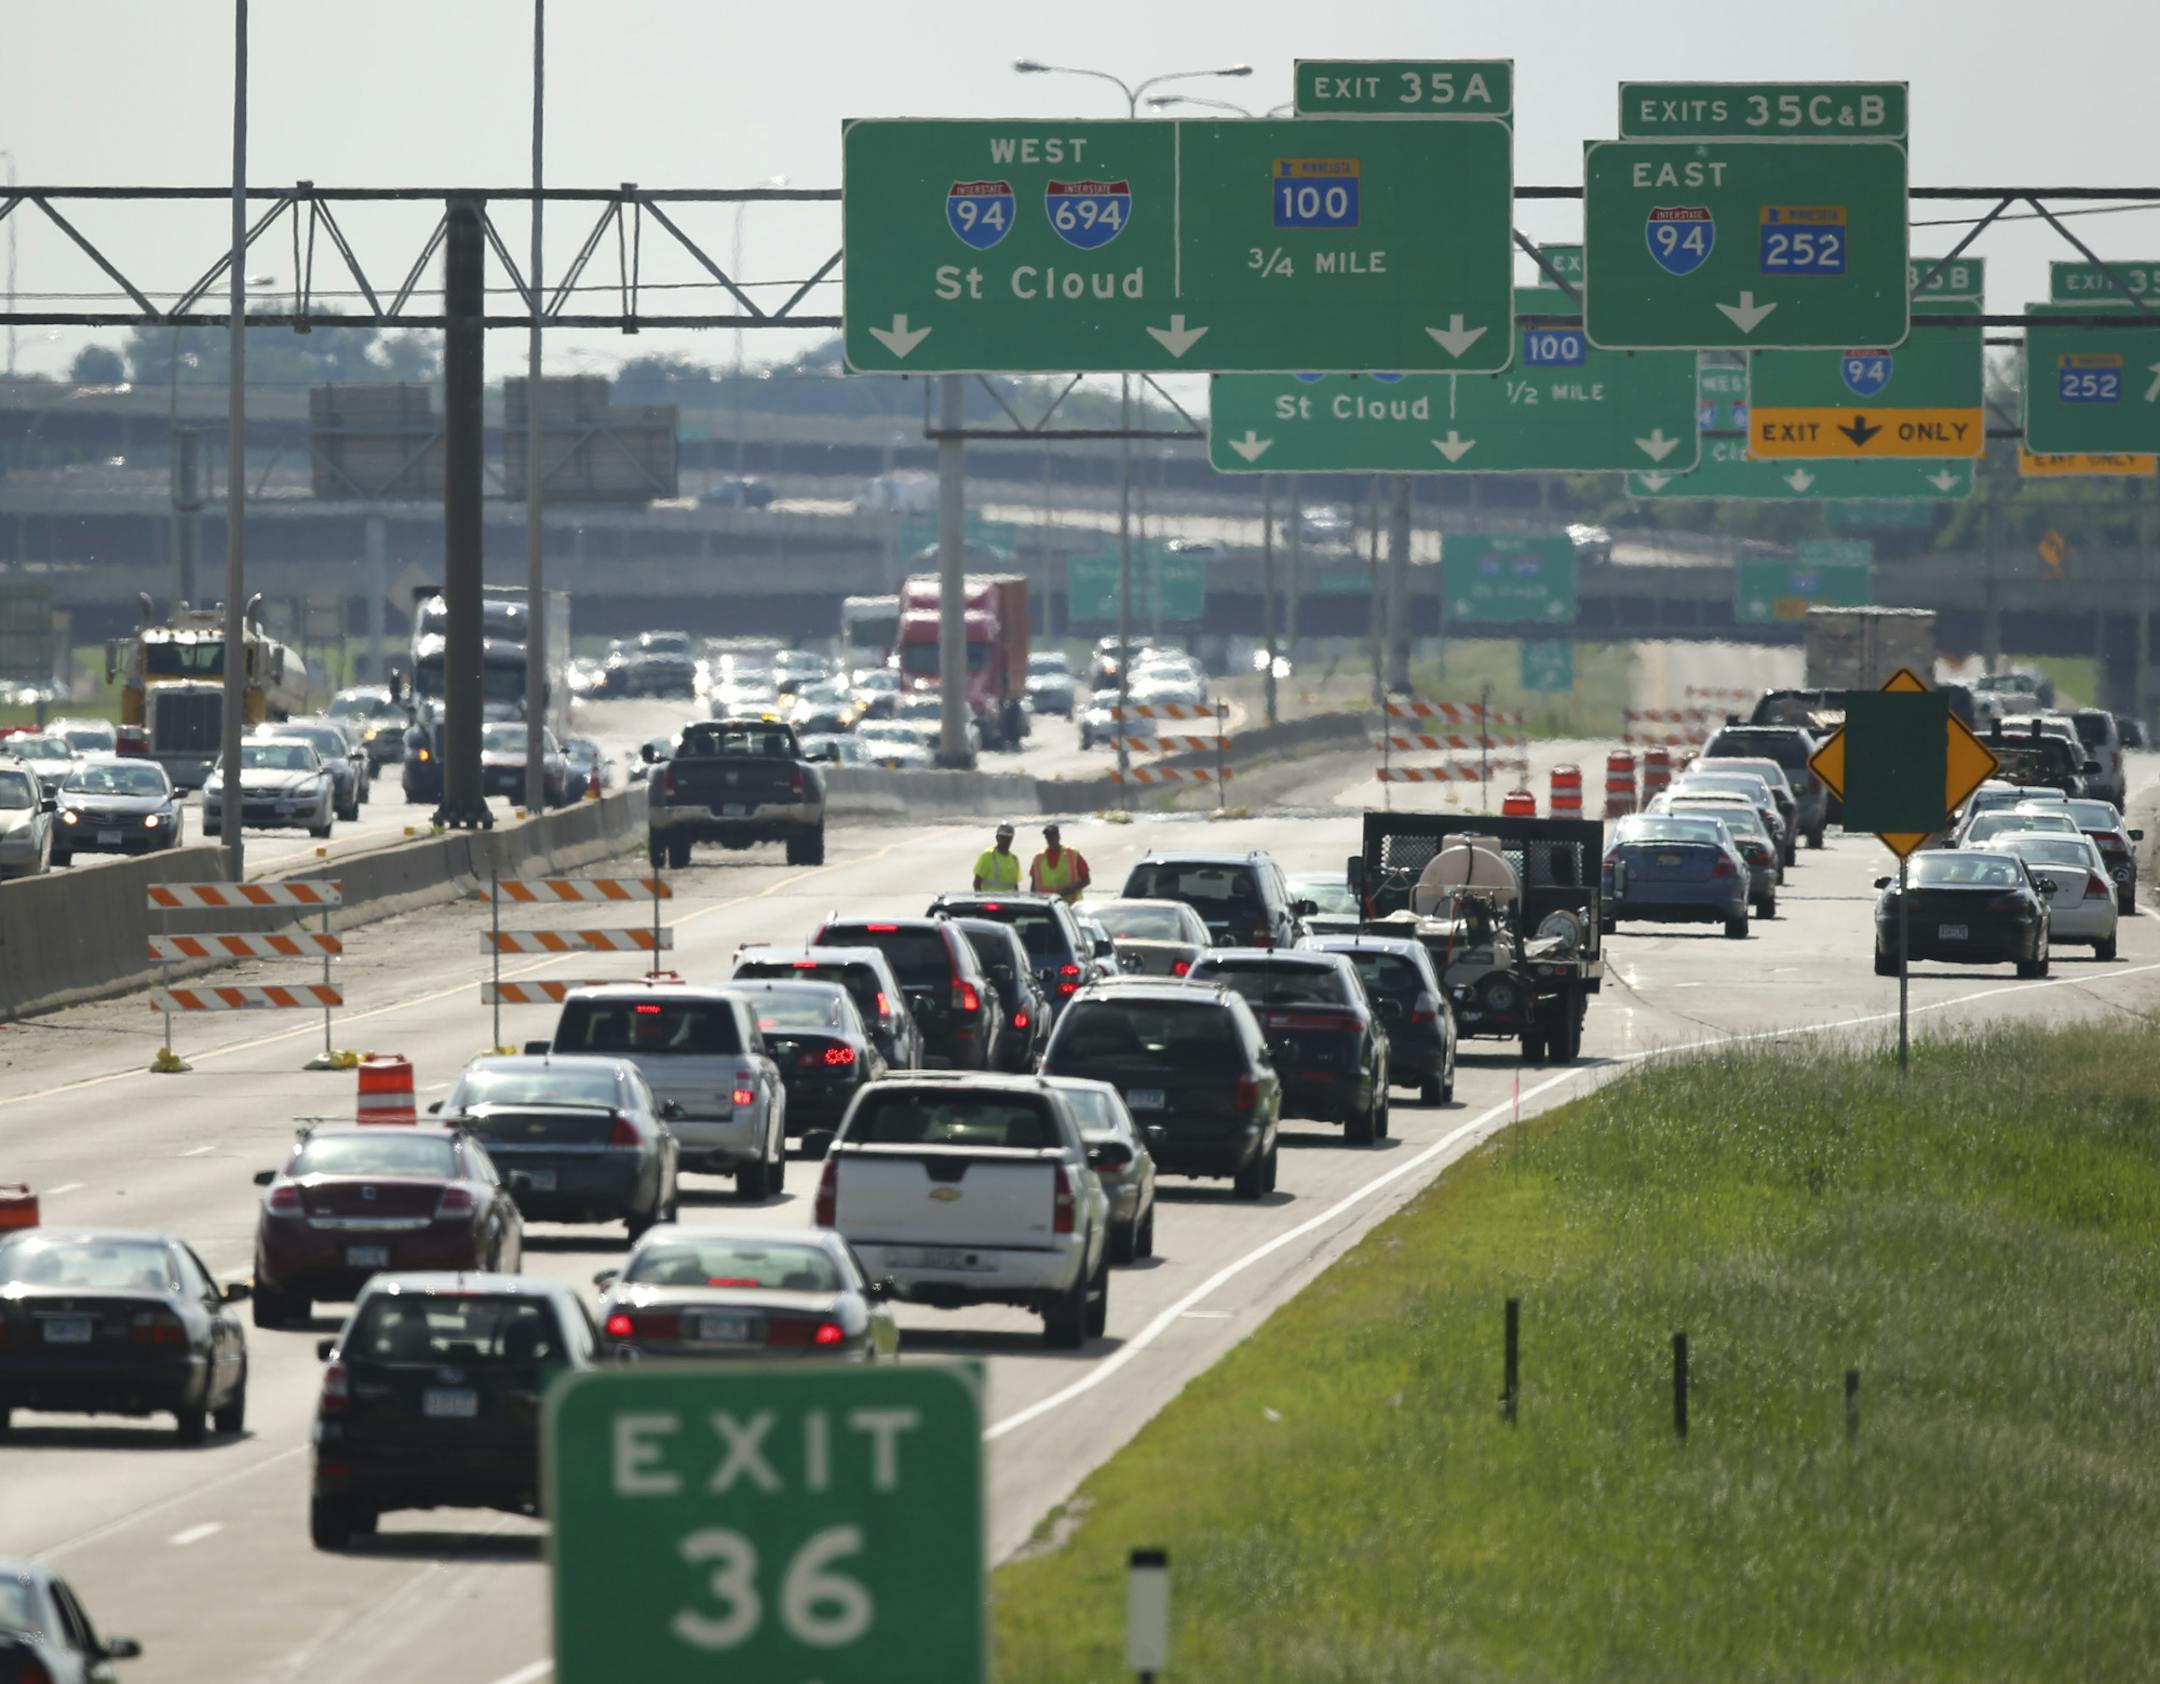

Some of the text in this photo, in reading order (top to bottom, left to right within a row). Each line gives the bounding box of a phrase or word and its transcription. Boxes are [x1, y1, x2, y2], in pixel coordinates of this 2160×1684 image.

[1314, 72, 1492, 103] EXIT 35A
[1640, 95, 1885, 127] EXITS 35C&B
[990, 138, 1088, 163] WEST
[1632, 162, 1728, 187] EAST
[957, 184, 1004, 194] INTERSTATE
[1064, 184, 1110, 194] INTERSTATE
[1055, 199, 1122, 230] 694
[1281, 186, 1349, 218] 100
[956, 200, 1005, 231] 94
[1656, 210, 1705, 220] INTERSTATE
[1656, 225, 1705, 256] 94
[1766, 233, 1840, 265] 252
[1316, 252, 1387, 273] MILE
[1553, 255, 1582, 272] EX
[935, 265, 1144, 299] St Cloud
[1530, 335, 1579, 360] 100
[1848, 360, 1885, 383] 94
[1551, 384, 1604, 400] MILE
[2063, 374, 2118, 397] 252
[1275, 395, 1430, 420] St Cloud
[1762, 422, 1968, 441] EXIT ONLY
[612, 1408, 922, 1495] EXIT
[671, 1523, 876, 1651] 36
